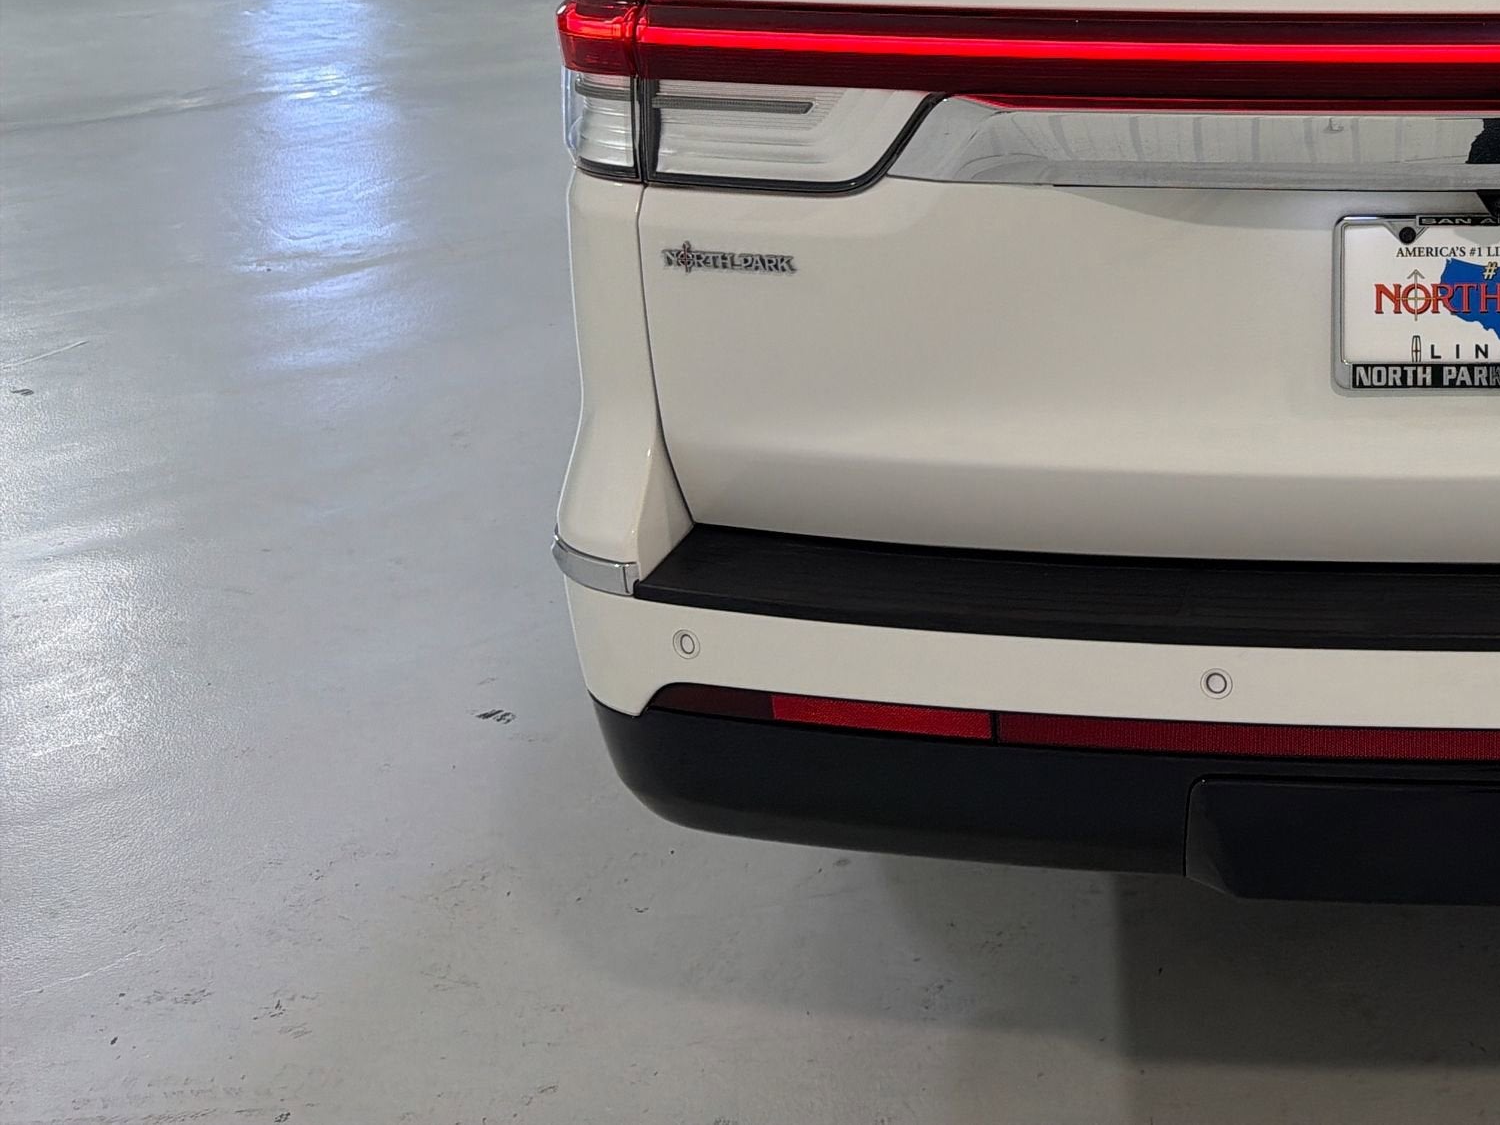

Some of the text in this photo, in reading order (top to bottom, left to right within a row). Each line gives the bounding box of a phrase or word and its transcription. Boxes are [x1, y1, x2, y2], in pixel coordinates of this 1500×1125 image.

[664, 249, 797, 274] NORTH PARK
[1396, 246, 1466, 258] AMERICA'S
[1469, 246, 1482, 257] #1
[1355, 366, 1433, 387] NORTH
